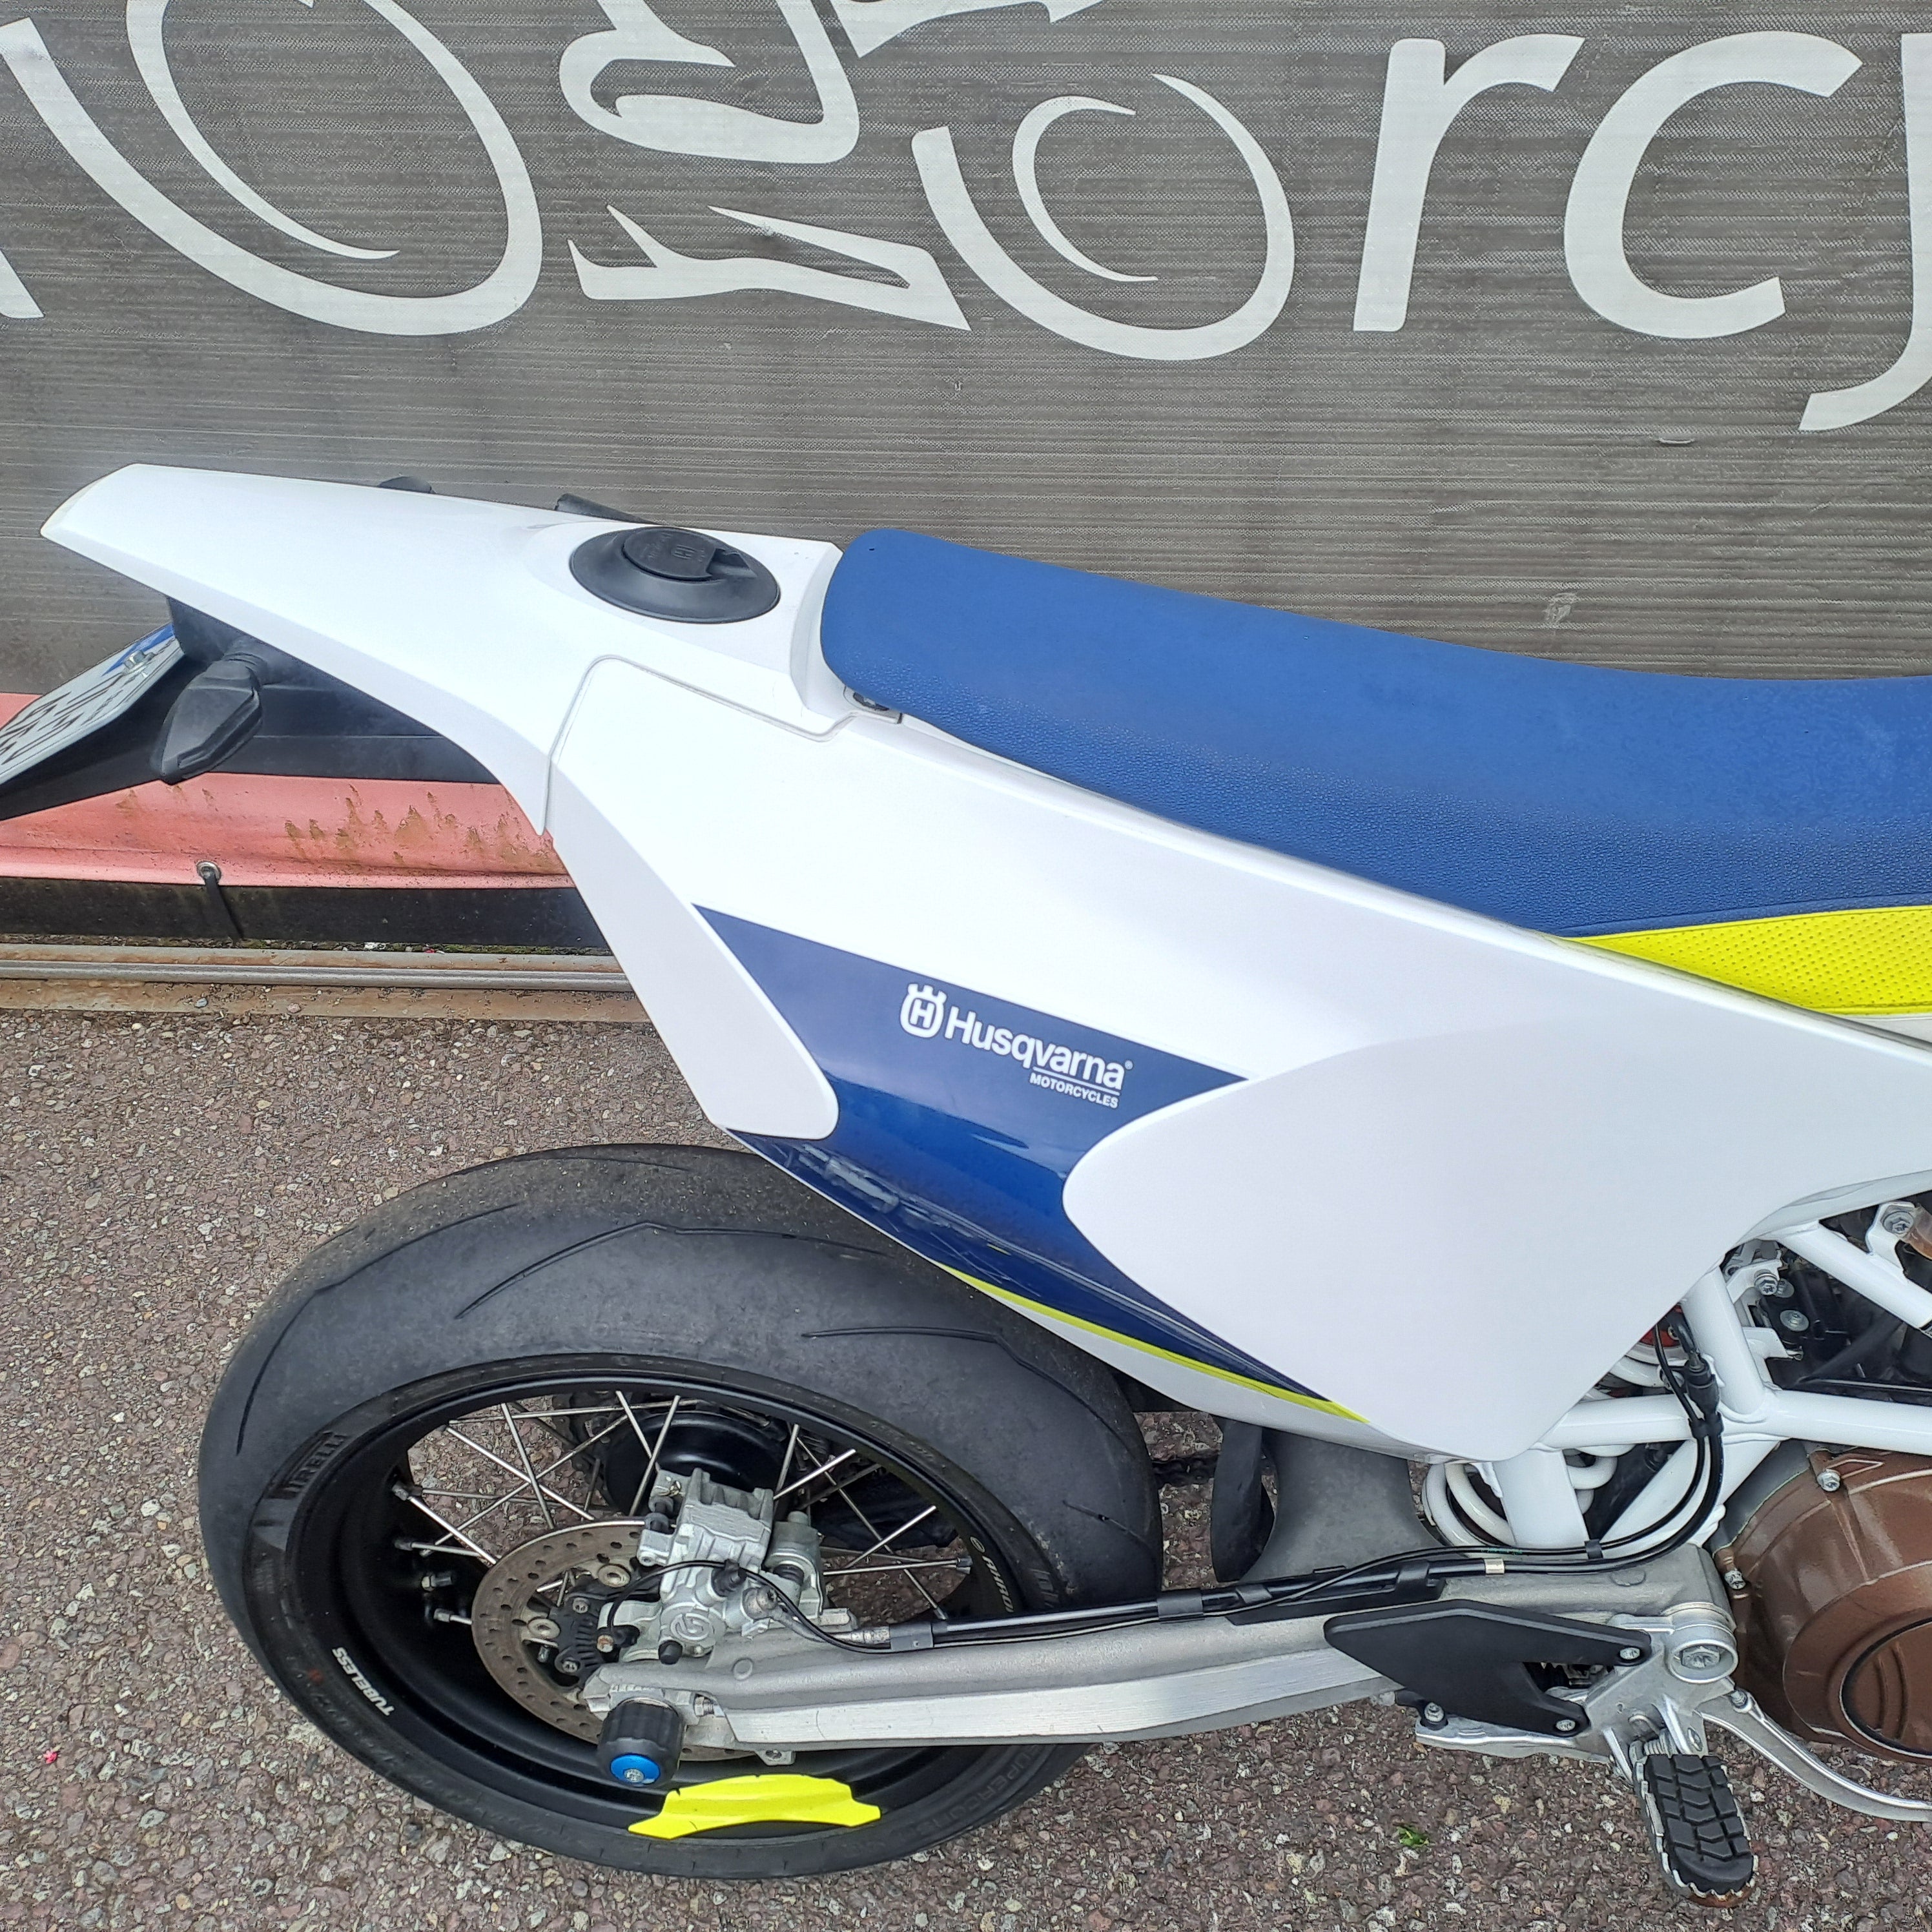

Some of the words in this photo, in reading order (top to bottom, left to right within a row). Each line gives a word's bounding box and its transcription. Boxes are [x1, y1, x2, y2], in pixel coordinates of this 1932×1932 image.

[945, 1005, 1125, 1091] Husqvarna
[1030, 1073, 1119, 1109] MOTORCYCLES
[332, 1647, 395, 1716] TUBELESS
